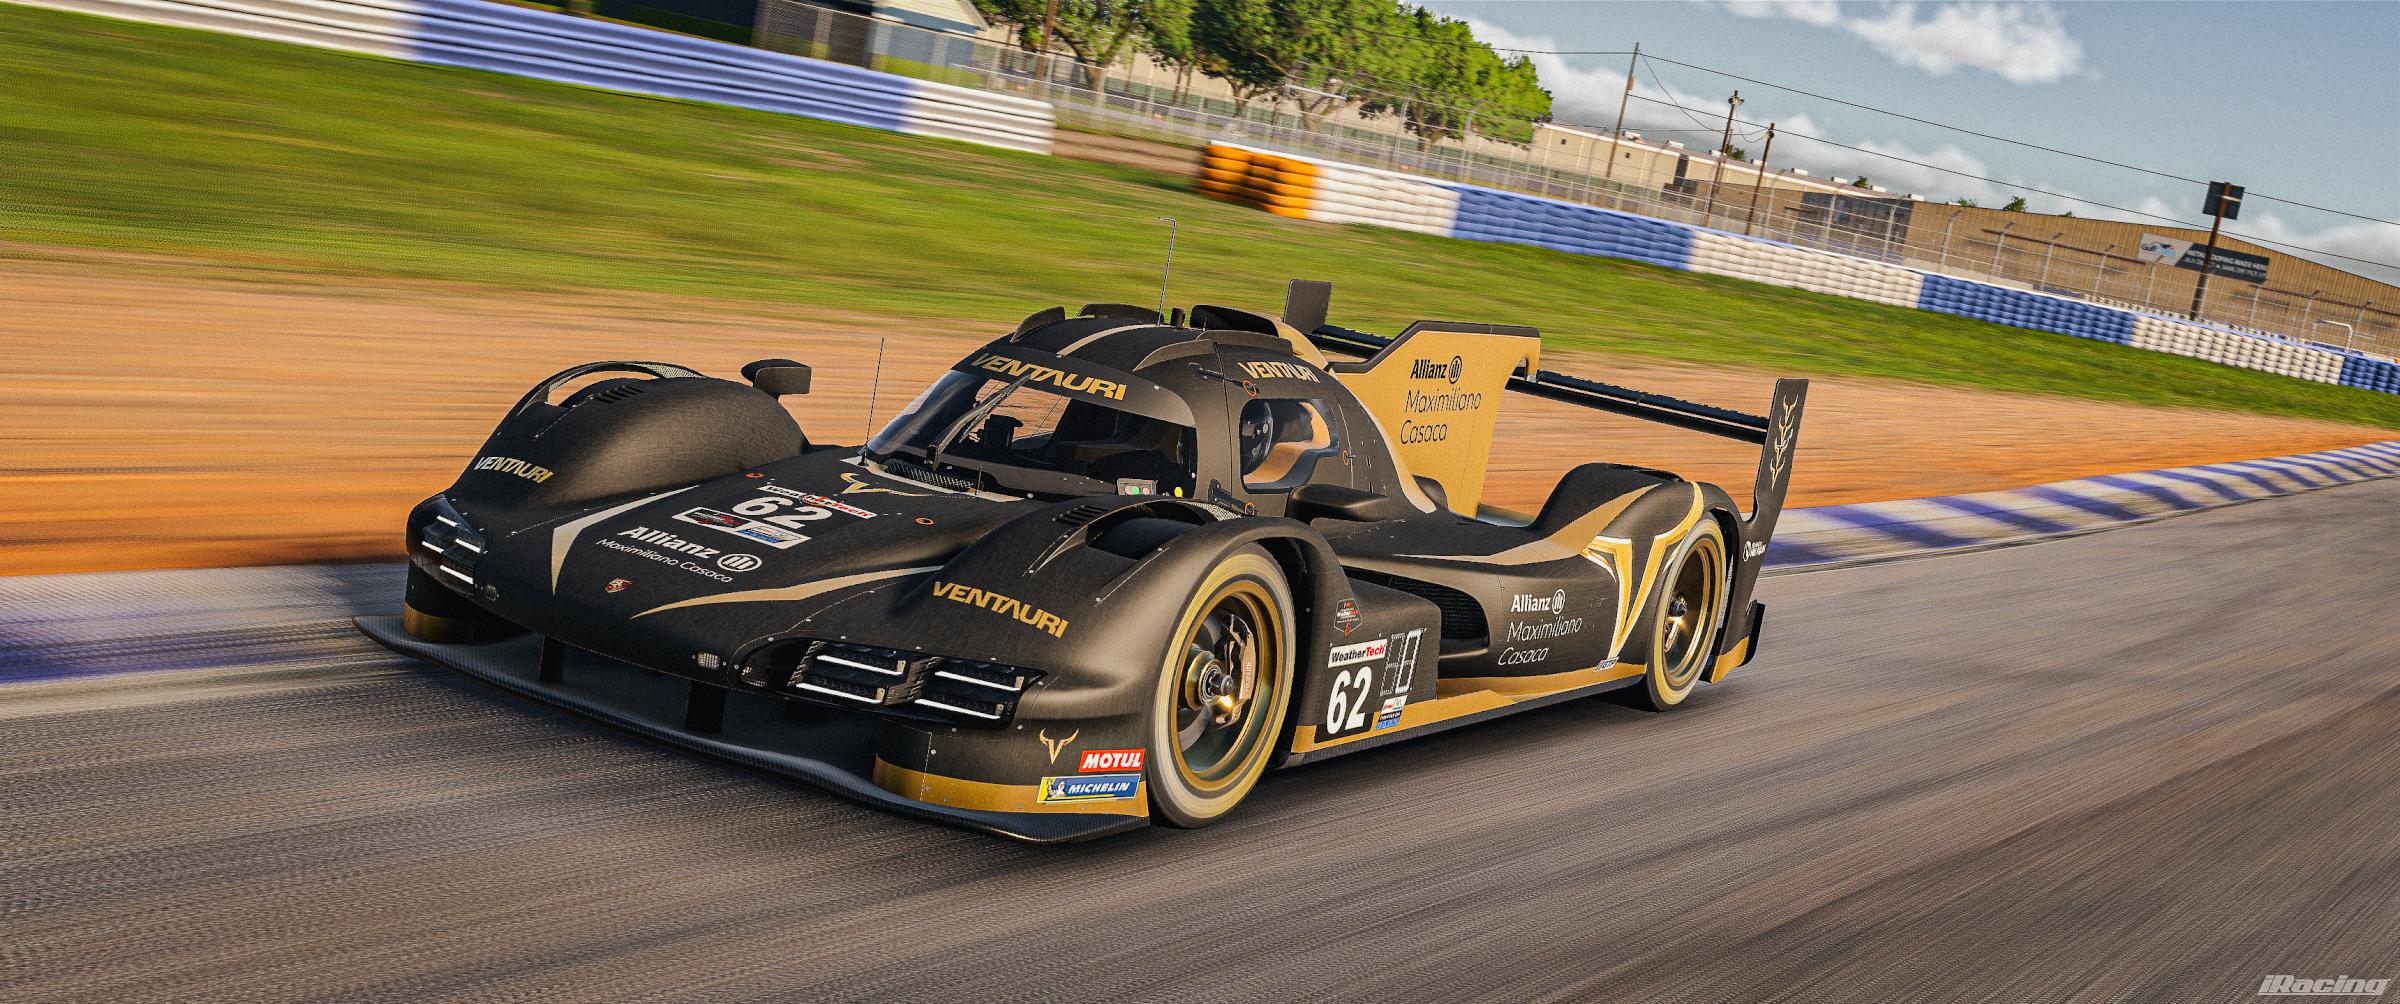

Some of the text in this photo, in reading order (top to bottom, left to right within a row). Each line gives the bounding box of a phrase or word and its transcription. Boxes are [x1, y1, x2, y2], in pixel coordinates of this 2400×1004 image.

[971, 353, 1127, 401] VENTAURI
[1237, 361, 1320, 383] VENTAURI
[1410, 359, 1447, 379] Allianz
[1405, 386, 1481, 413] Maximiliano
[1400, 420, 1448, 444] Casaca
[474, 457, 554, 483] VENTAURI
[732, 496, 832, 530] 62
[617, 526, 720, 559] Allianz
[596, 539, 733, 583] Maximiliano Casaca
[933, 581, 1069, 638] VENTAURI
[1511, 594, 1551, 612] Allianz
[1507, 615, 1583, 642] Maximiliano
[1332, 644, 1385, 663] WeatherTech
[1498, 646, 1549, 665] Casaca
[1327, 666, 1372, 735] 62
[1082, 752, 1141, 769] MOTUL
[1068, 782, 1130, 794] MICHELIN
